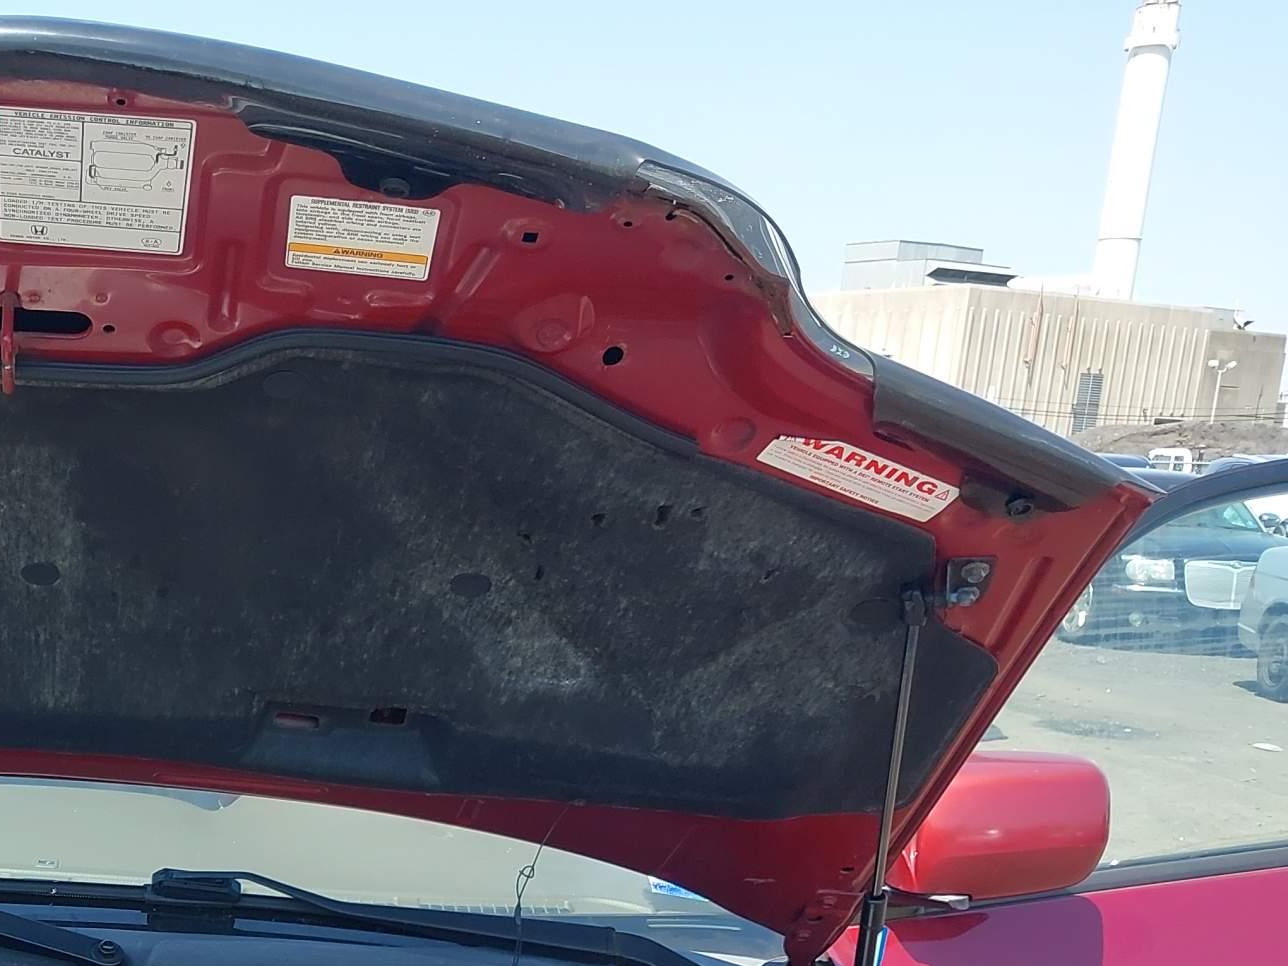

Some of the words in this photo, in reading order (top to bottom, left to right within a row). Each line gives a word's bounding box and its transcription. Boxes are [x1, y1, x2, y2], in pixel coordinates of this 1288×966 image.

[49, 113, 85, 121] EMISSION
[89, 116, 120, 124] CONTROL
[125, 118, 174, 127] INFORMATION
[12, 146, 71, 158] CATALYST
[310, 198, 350, 207] SUPPLEMENTAL
[351, 202, 380, 210] RESTRAINT
[341, 249, 383, 258] WARNING
[802, 438, 938, 495] WARNING
